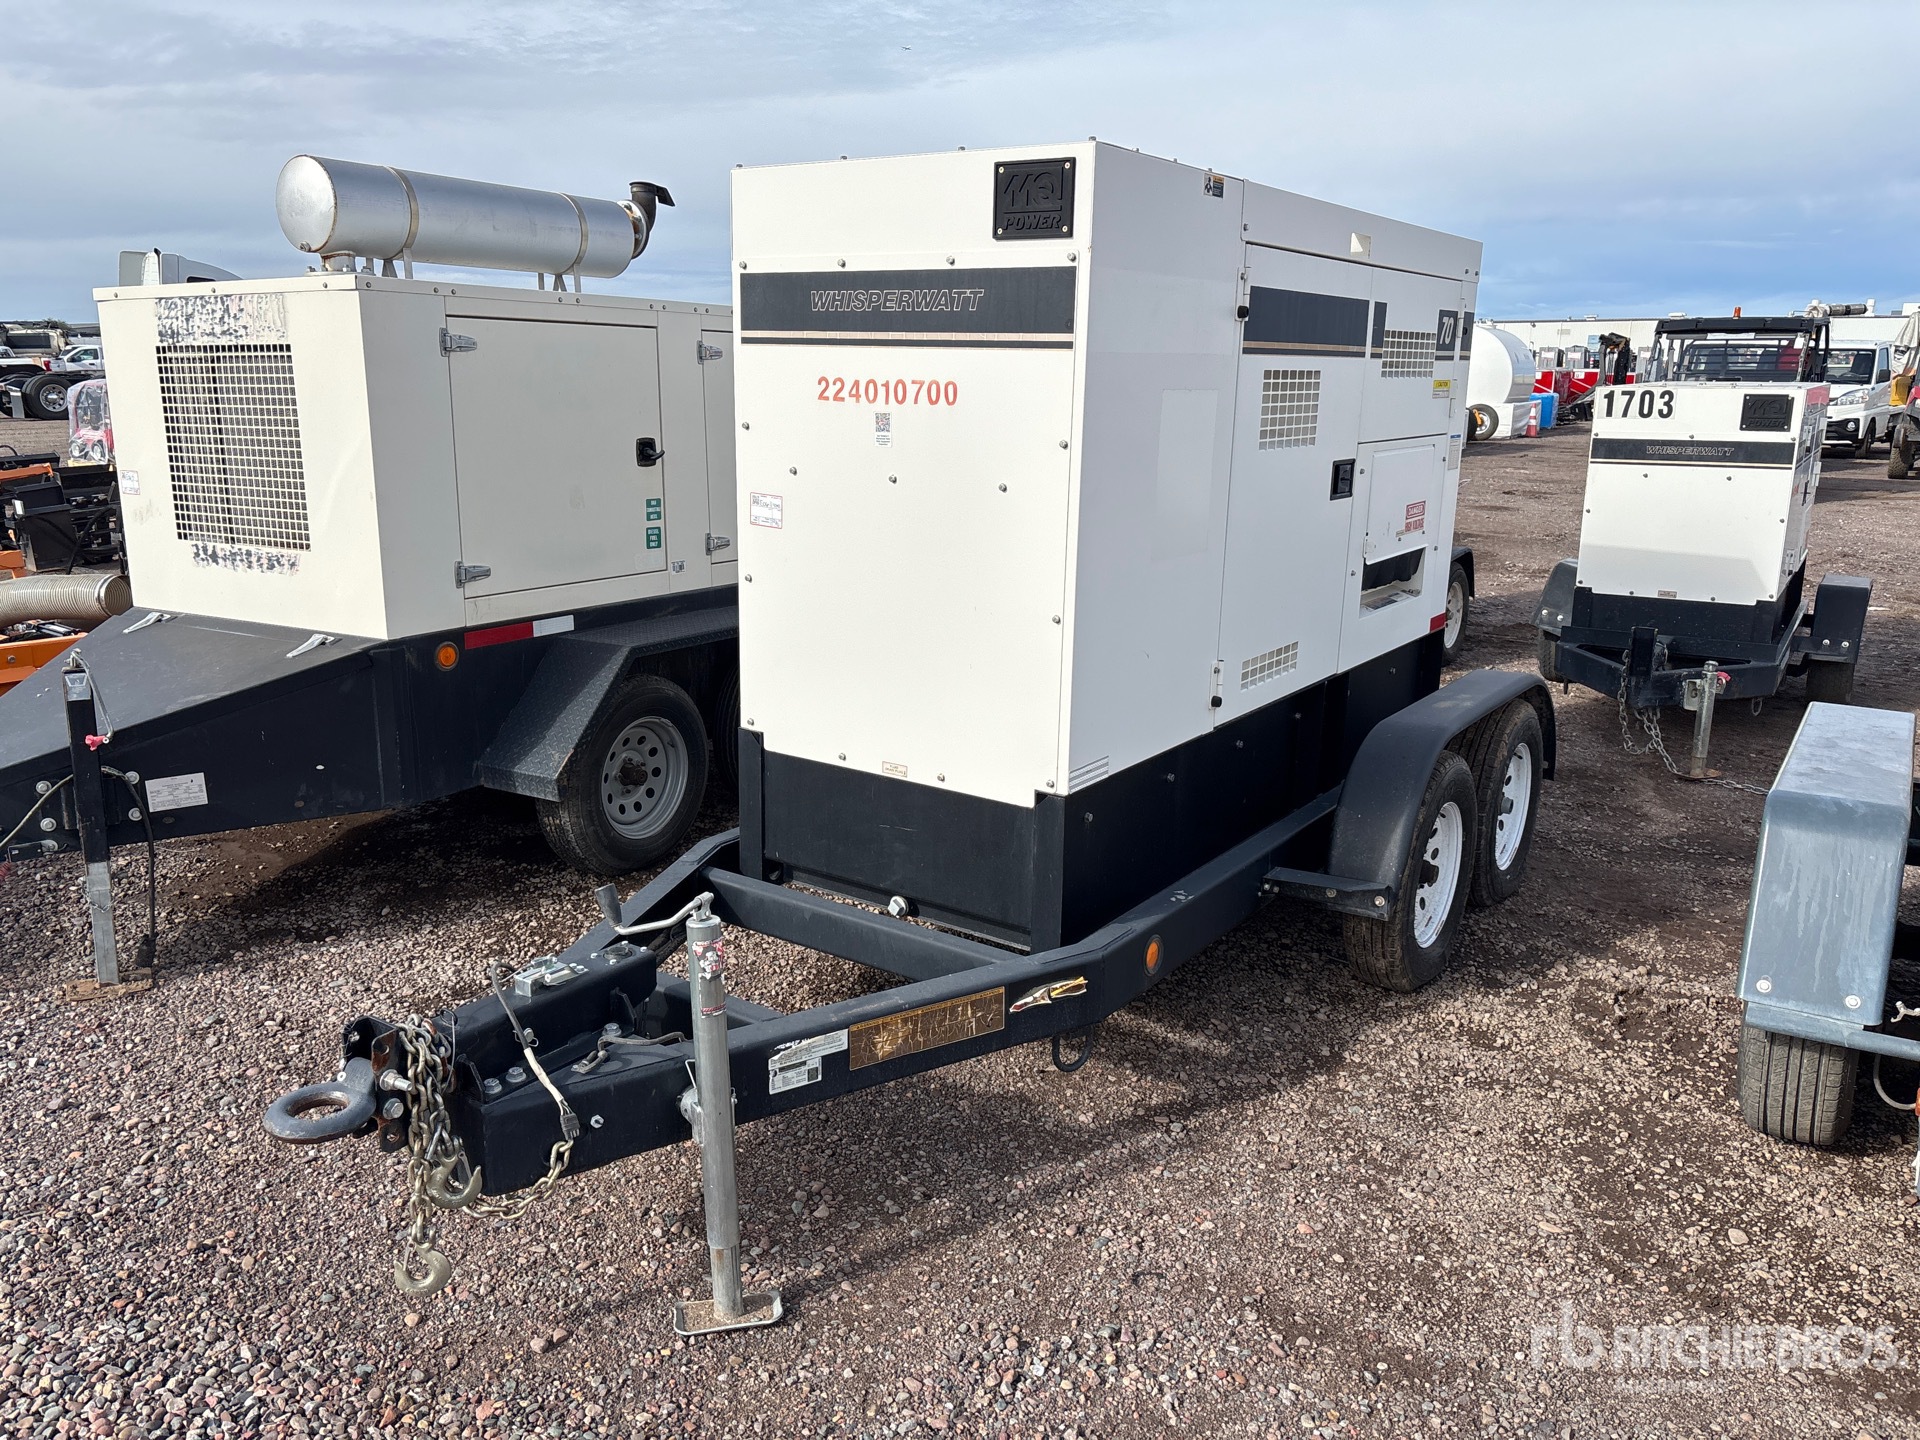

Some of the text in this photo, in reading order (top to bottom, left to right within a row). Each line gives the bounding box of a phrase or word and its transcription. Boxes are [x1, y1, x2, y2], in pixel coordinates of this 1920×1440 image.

[1003, 214, 1062, 231] POWER
[810, 288, 985, 312] WHISPERWATT
[1440, 316, 1454, 345] 70
[817, 375, 959, 407] 224010700
[1603, 389, 1675, 419] 1703
[1748, 420, 1786, 428] POWER
[1646, 445, 1735, 456] WHISPERWATT
